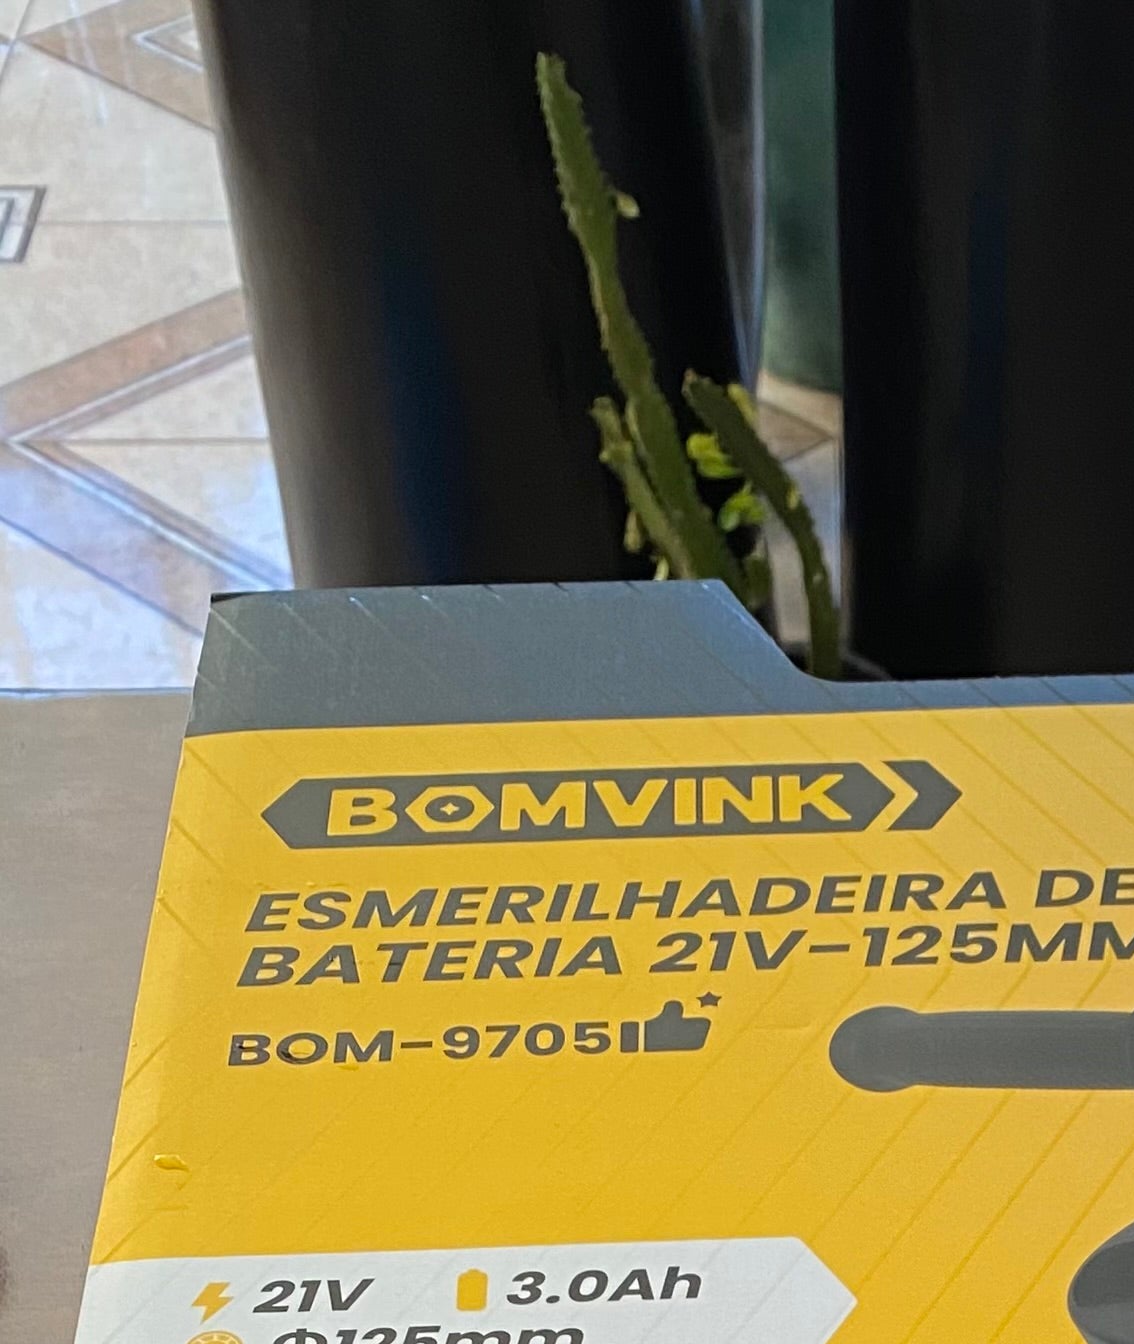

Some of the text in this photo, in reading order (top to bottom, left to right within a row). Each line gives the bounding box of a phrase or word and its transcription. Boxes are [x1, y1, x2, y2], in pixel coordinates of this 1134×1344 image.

[327, 774, 853, 836] BOMVINK
[244, 872, 1006, 933] ESMERILHADEIRA
[236, 935, 624, 987] BATERIA
[228, 1021, 613, 1067] BOM-9705
[252, 1265, 702, 1314] 21V 3.0Ah
